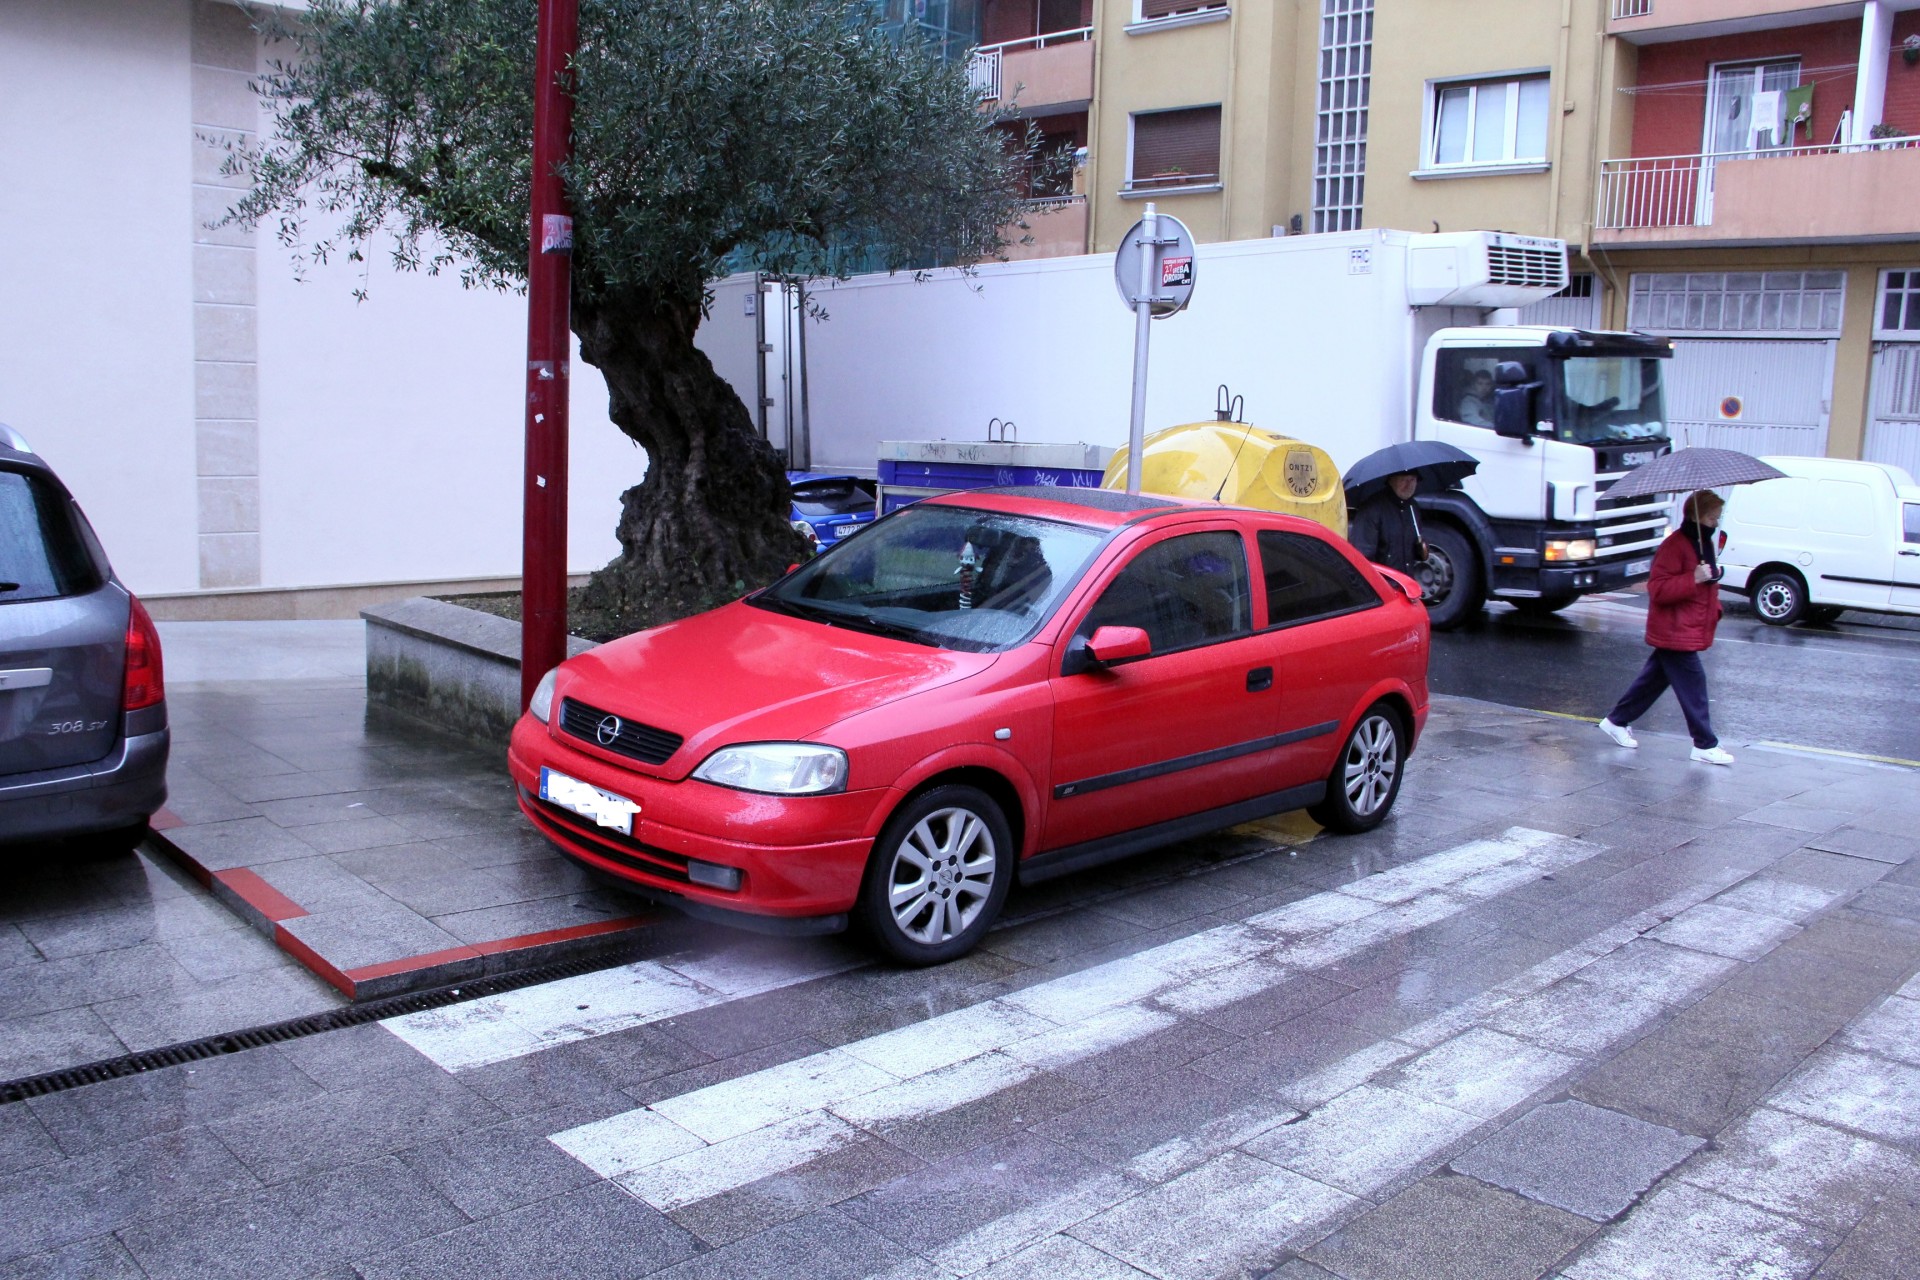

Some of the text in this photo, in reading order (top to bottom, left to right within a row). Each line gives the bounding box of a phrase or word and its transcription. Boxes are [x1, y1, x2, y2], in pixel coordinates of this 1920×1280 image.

[1288, 463, 1313, 473] ONTZI
[1287, 476, 1316, 495] BILKETA
[47, 720, 84, 736] 308
